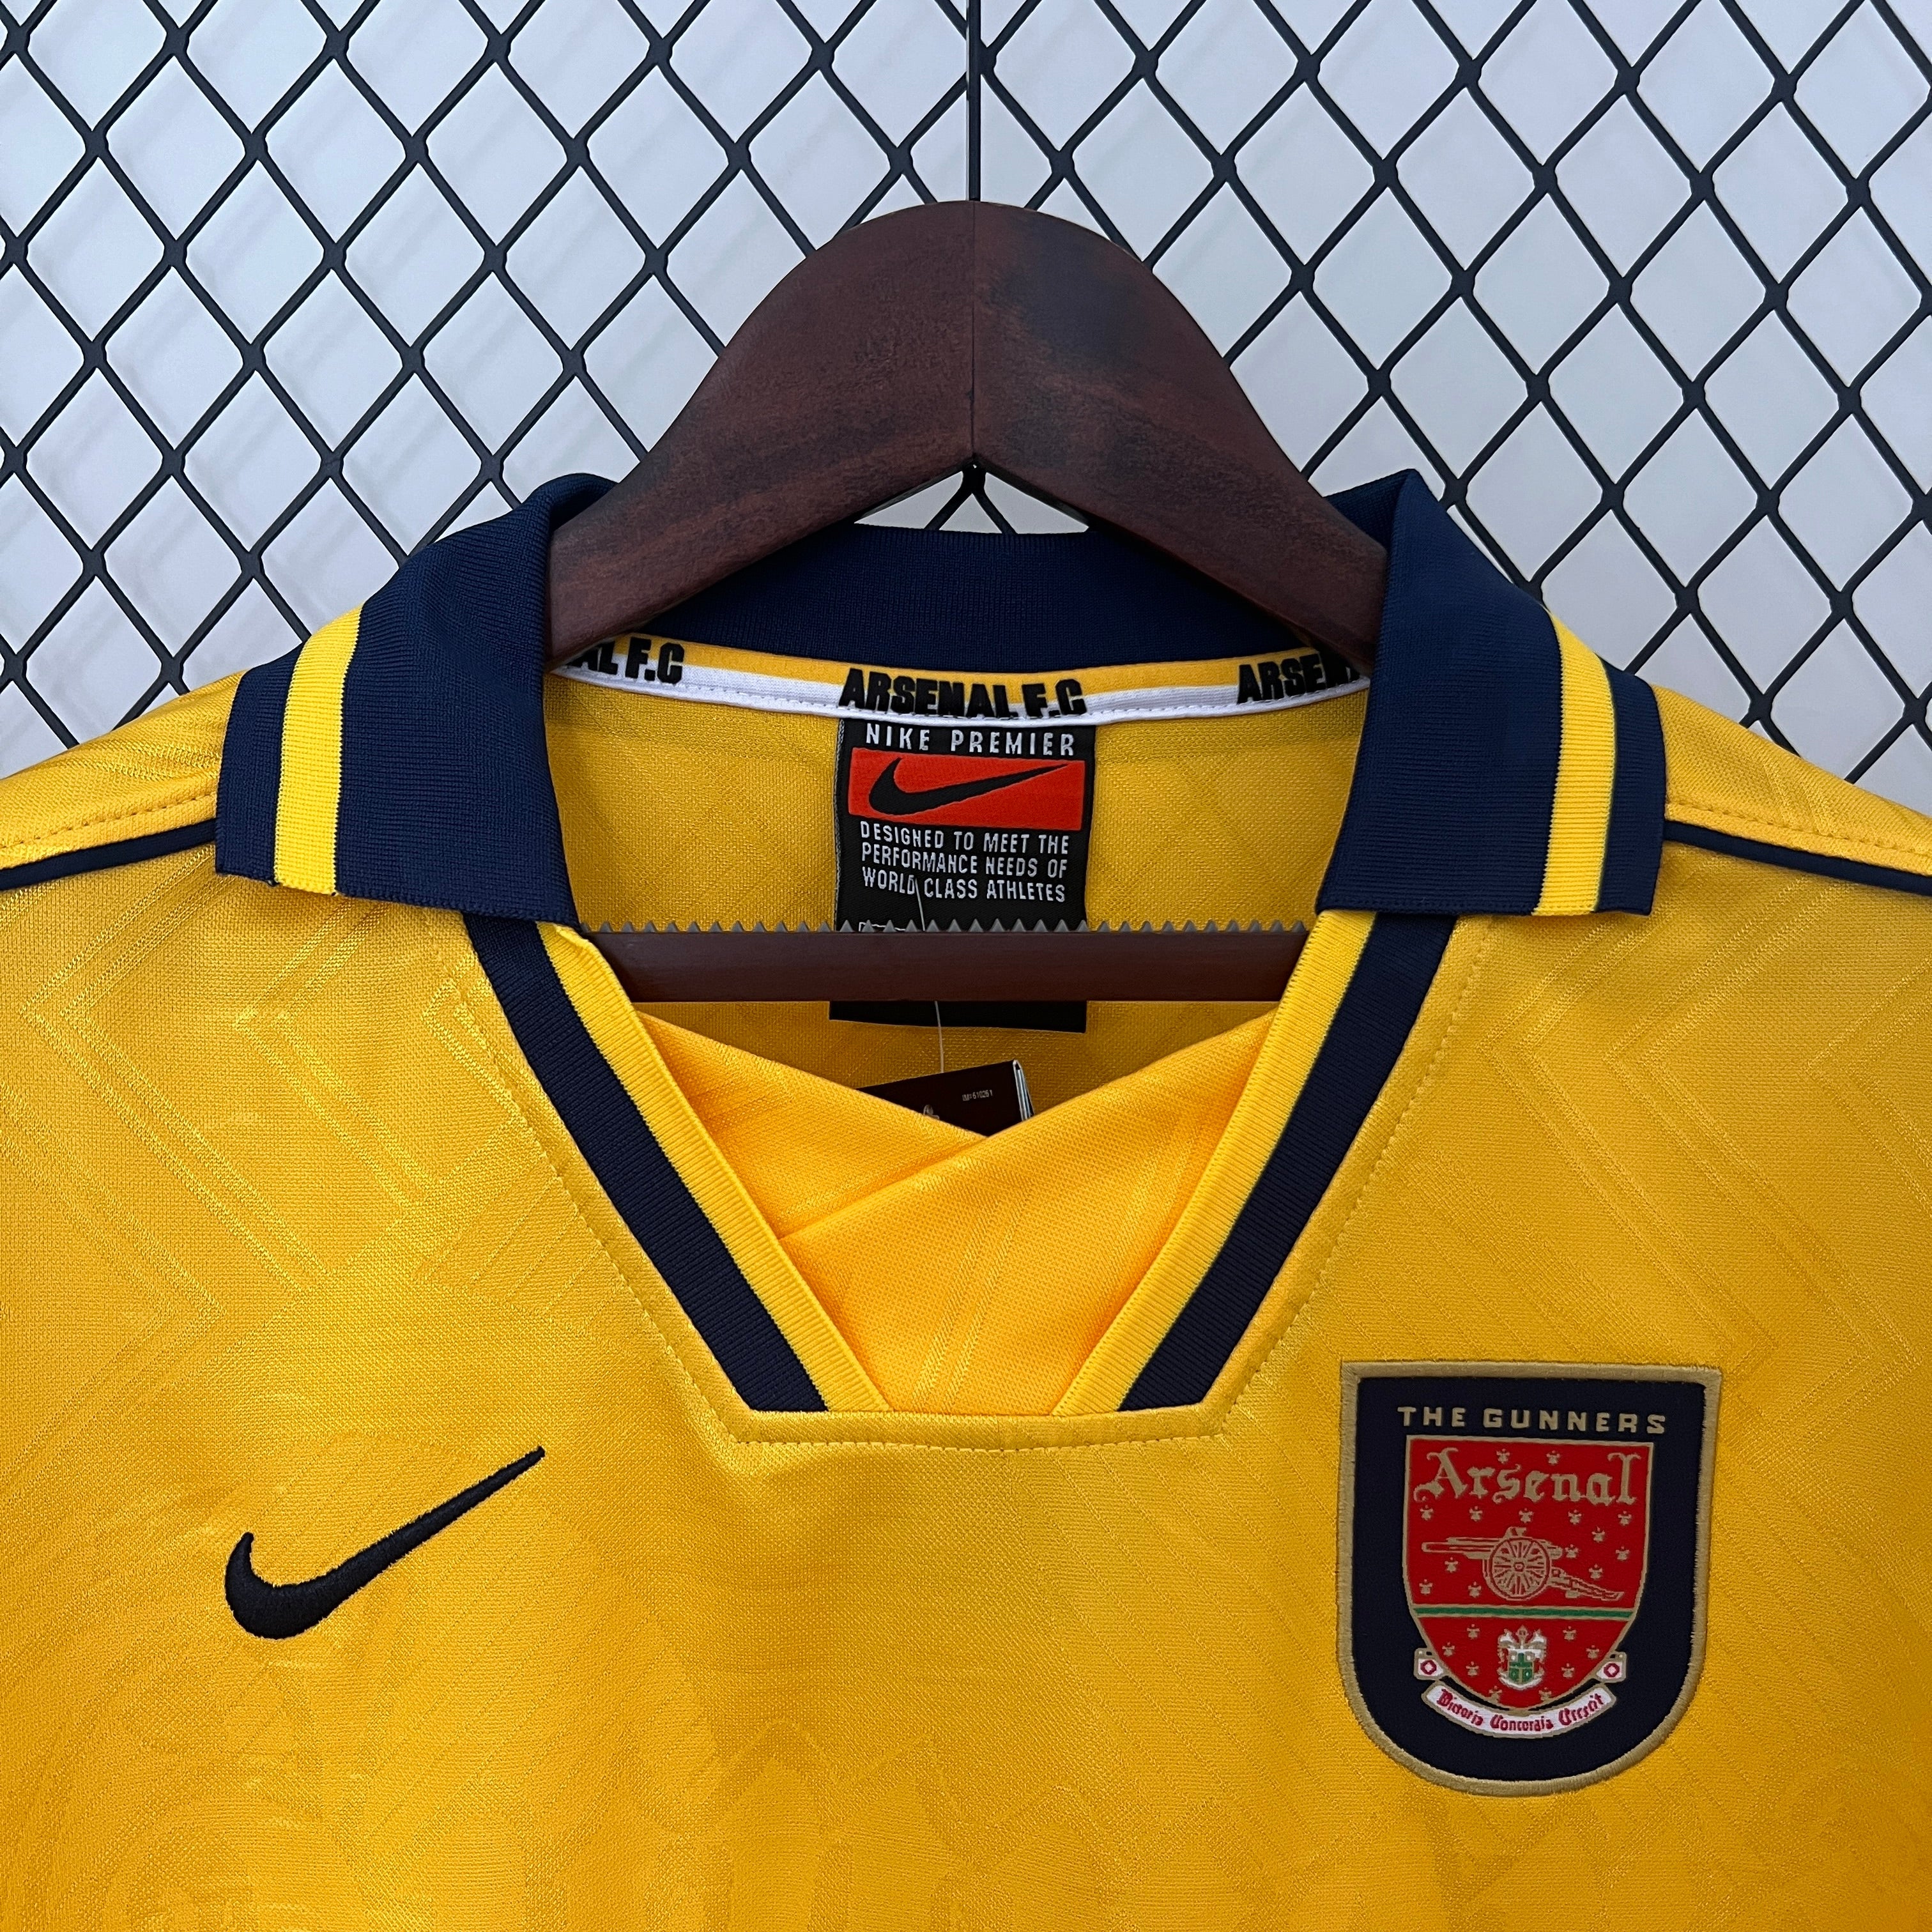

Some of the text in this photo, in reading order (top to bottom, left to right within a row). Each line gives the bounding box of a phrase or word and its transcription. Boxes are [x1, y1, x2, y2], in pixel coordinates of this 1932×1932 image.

[625, 637, 685, 685] F.C
[838, 668, 1087, 718] ARSENAL F.C
[865, 723, 1075, 756] NIKE PREMIER
[861, 821, 1069, 855] DESIGNED TO MEET THE
[861, 842, 1068, 878] PERFORMANCE NEEDS OF
[862, 866, 1065, 903] WORLD CLASS ATHLETES
[1397, 1406, 1666, 1434] THE GUNNERS
[1413, 1446, 1642, 1506] Arsenal
